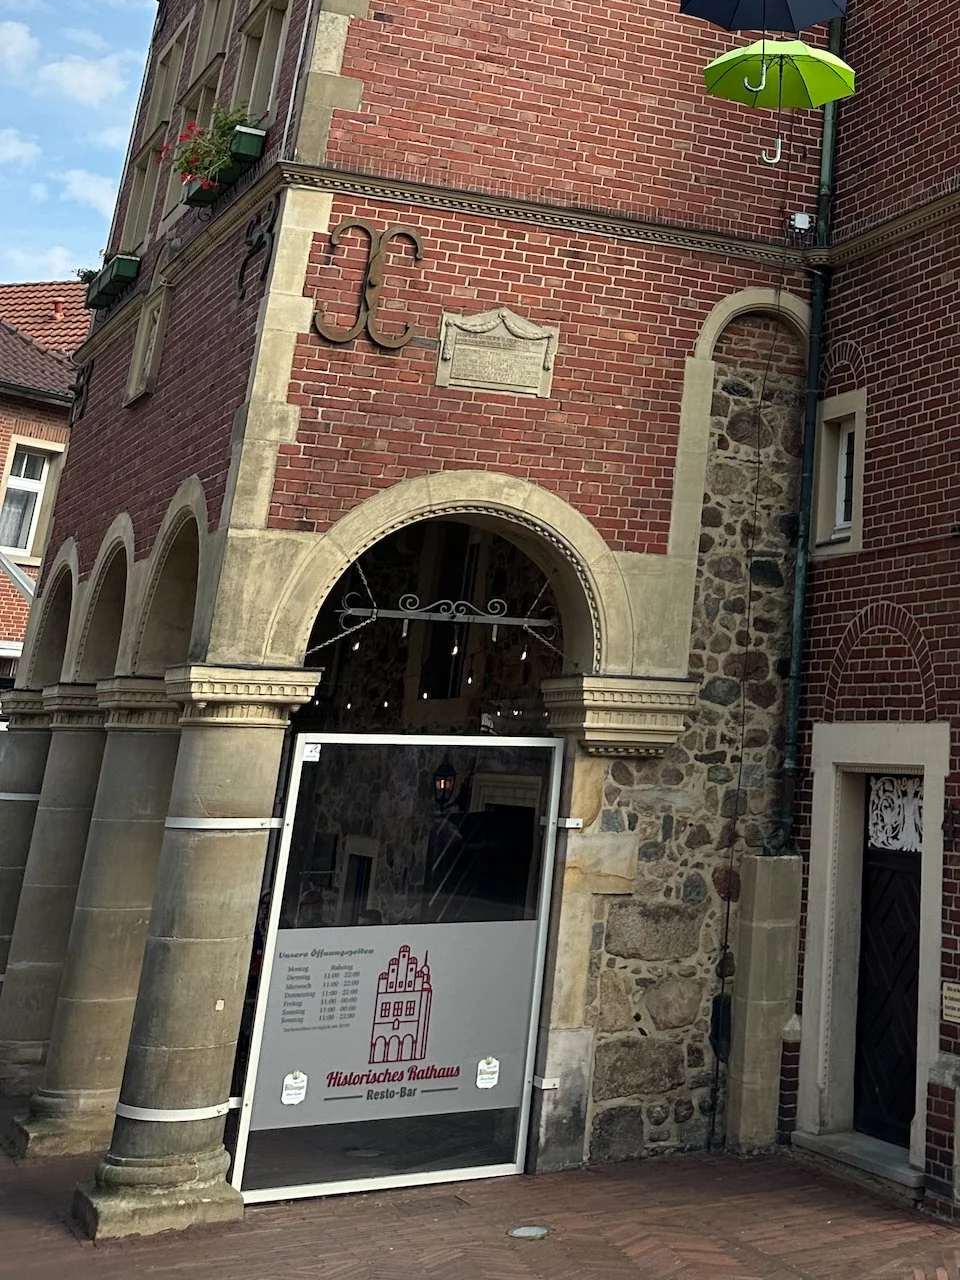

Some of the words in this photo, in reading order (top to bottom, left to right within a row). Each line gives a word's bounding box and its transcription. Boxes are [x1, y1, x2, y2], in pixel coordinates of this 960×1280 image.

[279, 951, 309, 959] Unsere
[311, 948, 374, 958] Öffnungszeiten
[326, 1068, 405, 1088] Historisches
[407, 1064, 461, 1081] Rathaus
[366, 1086, 418, 1101] Resto-Bar
